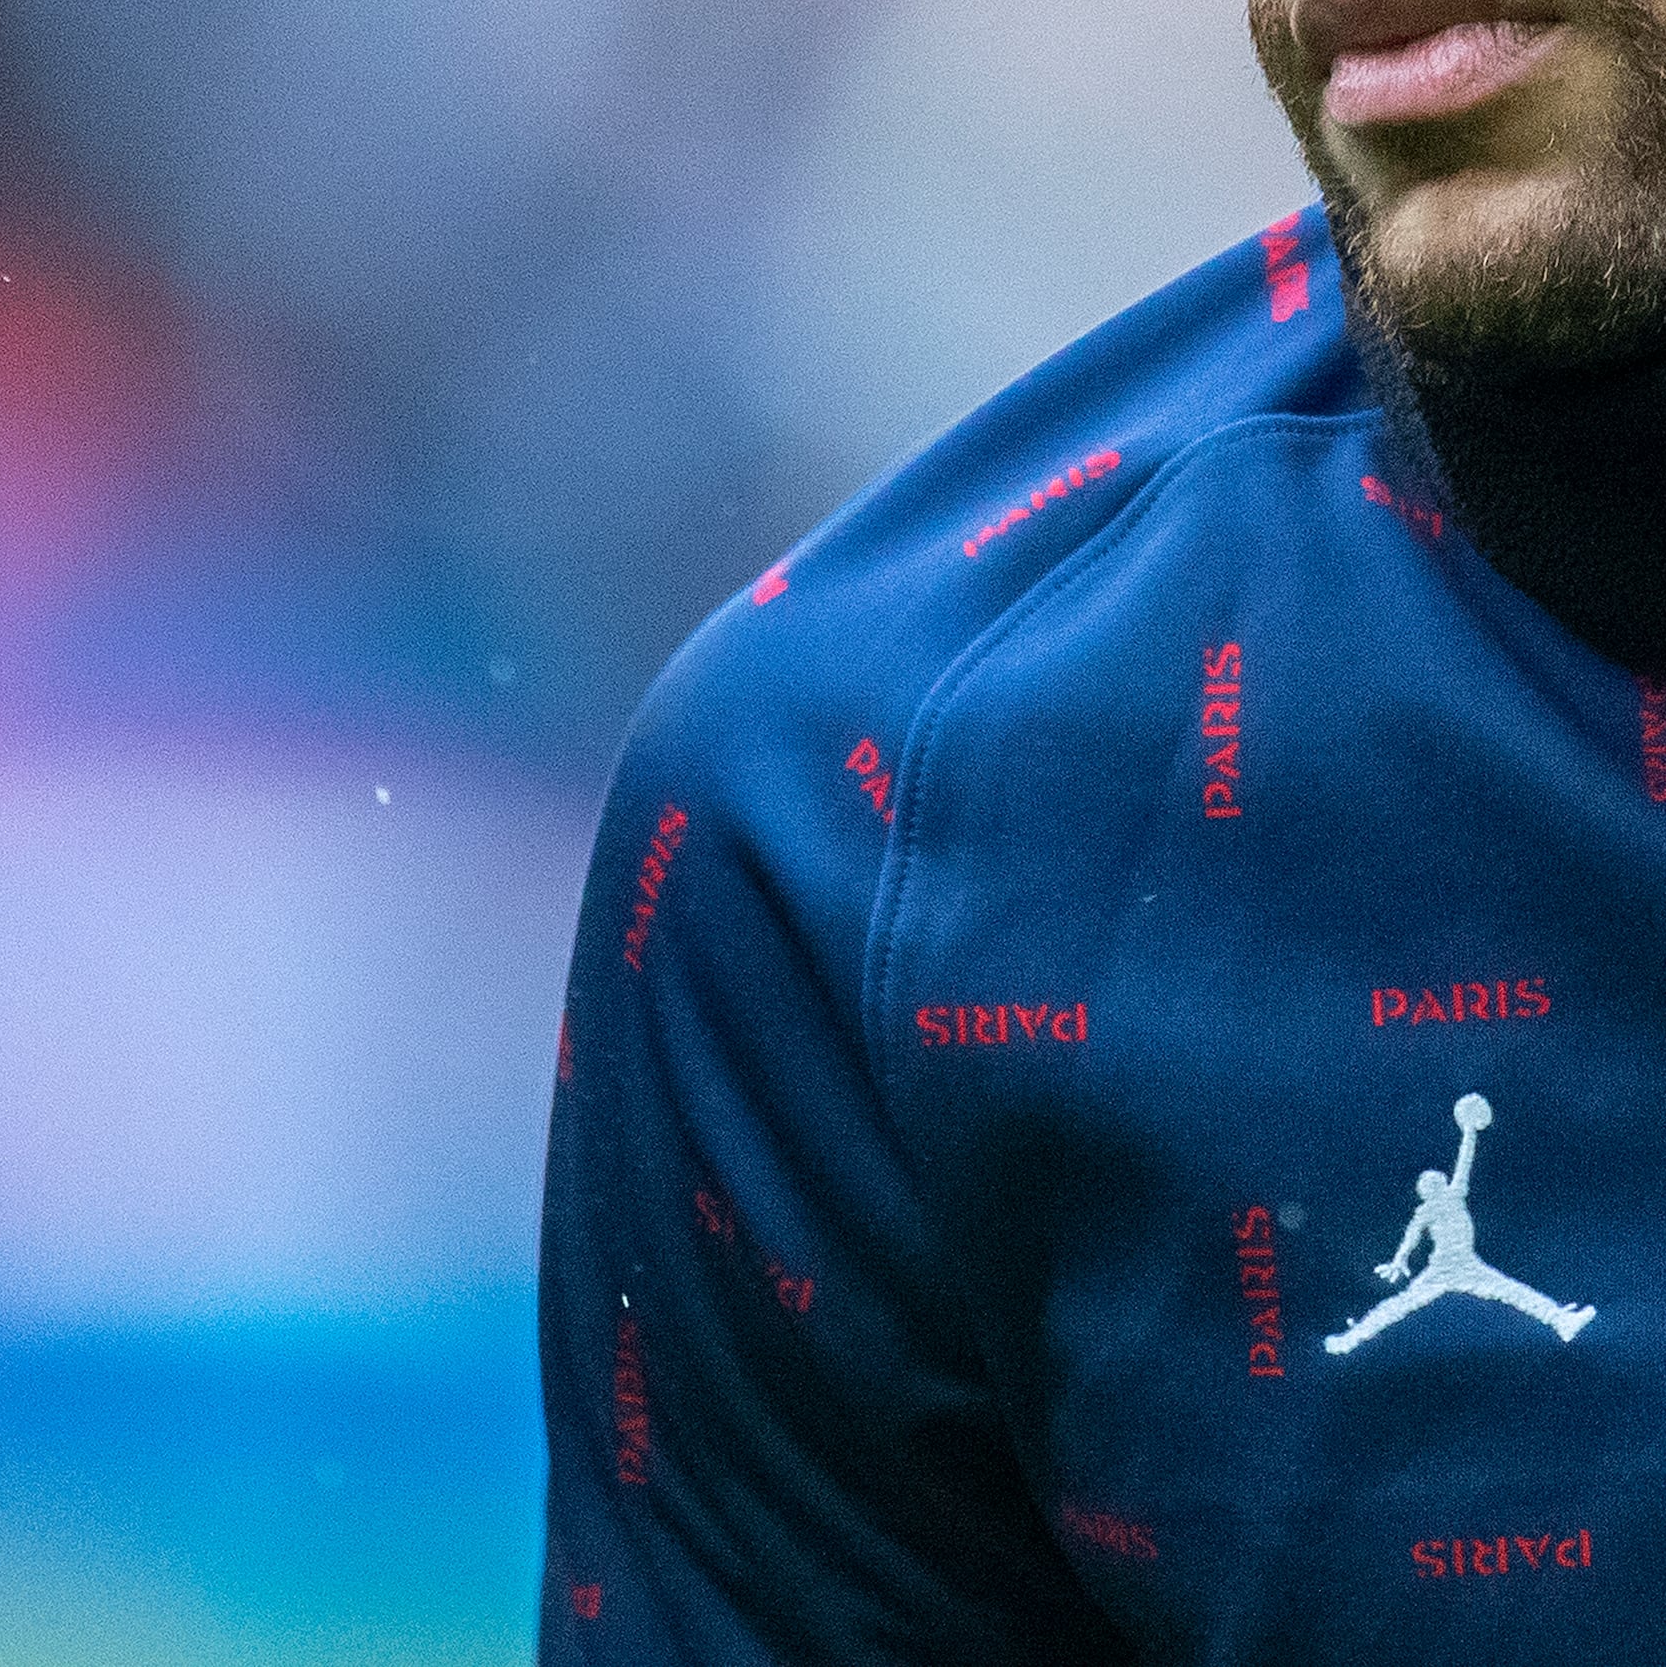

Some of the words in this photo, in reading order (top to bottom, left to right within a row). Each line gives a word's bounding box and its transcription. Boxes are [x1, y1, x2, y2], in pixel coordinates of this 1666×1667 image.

[1203, 643, 1241, 818] PARIS
[917, 1003, 1087, 1044] PARIS
[1372, 980, 1550, 1026] PARIS
[1236, 1206, 1284, 1376] PARIS
[1412, 1530, 1591, 1576] PARIS
